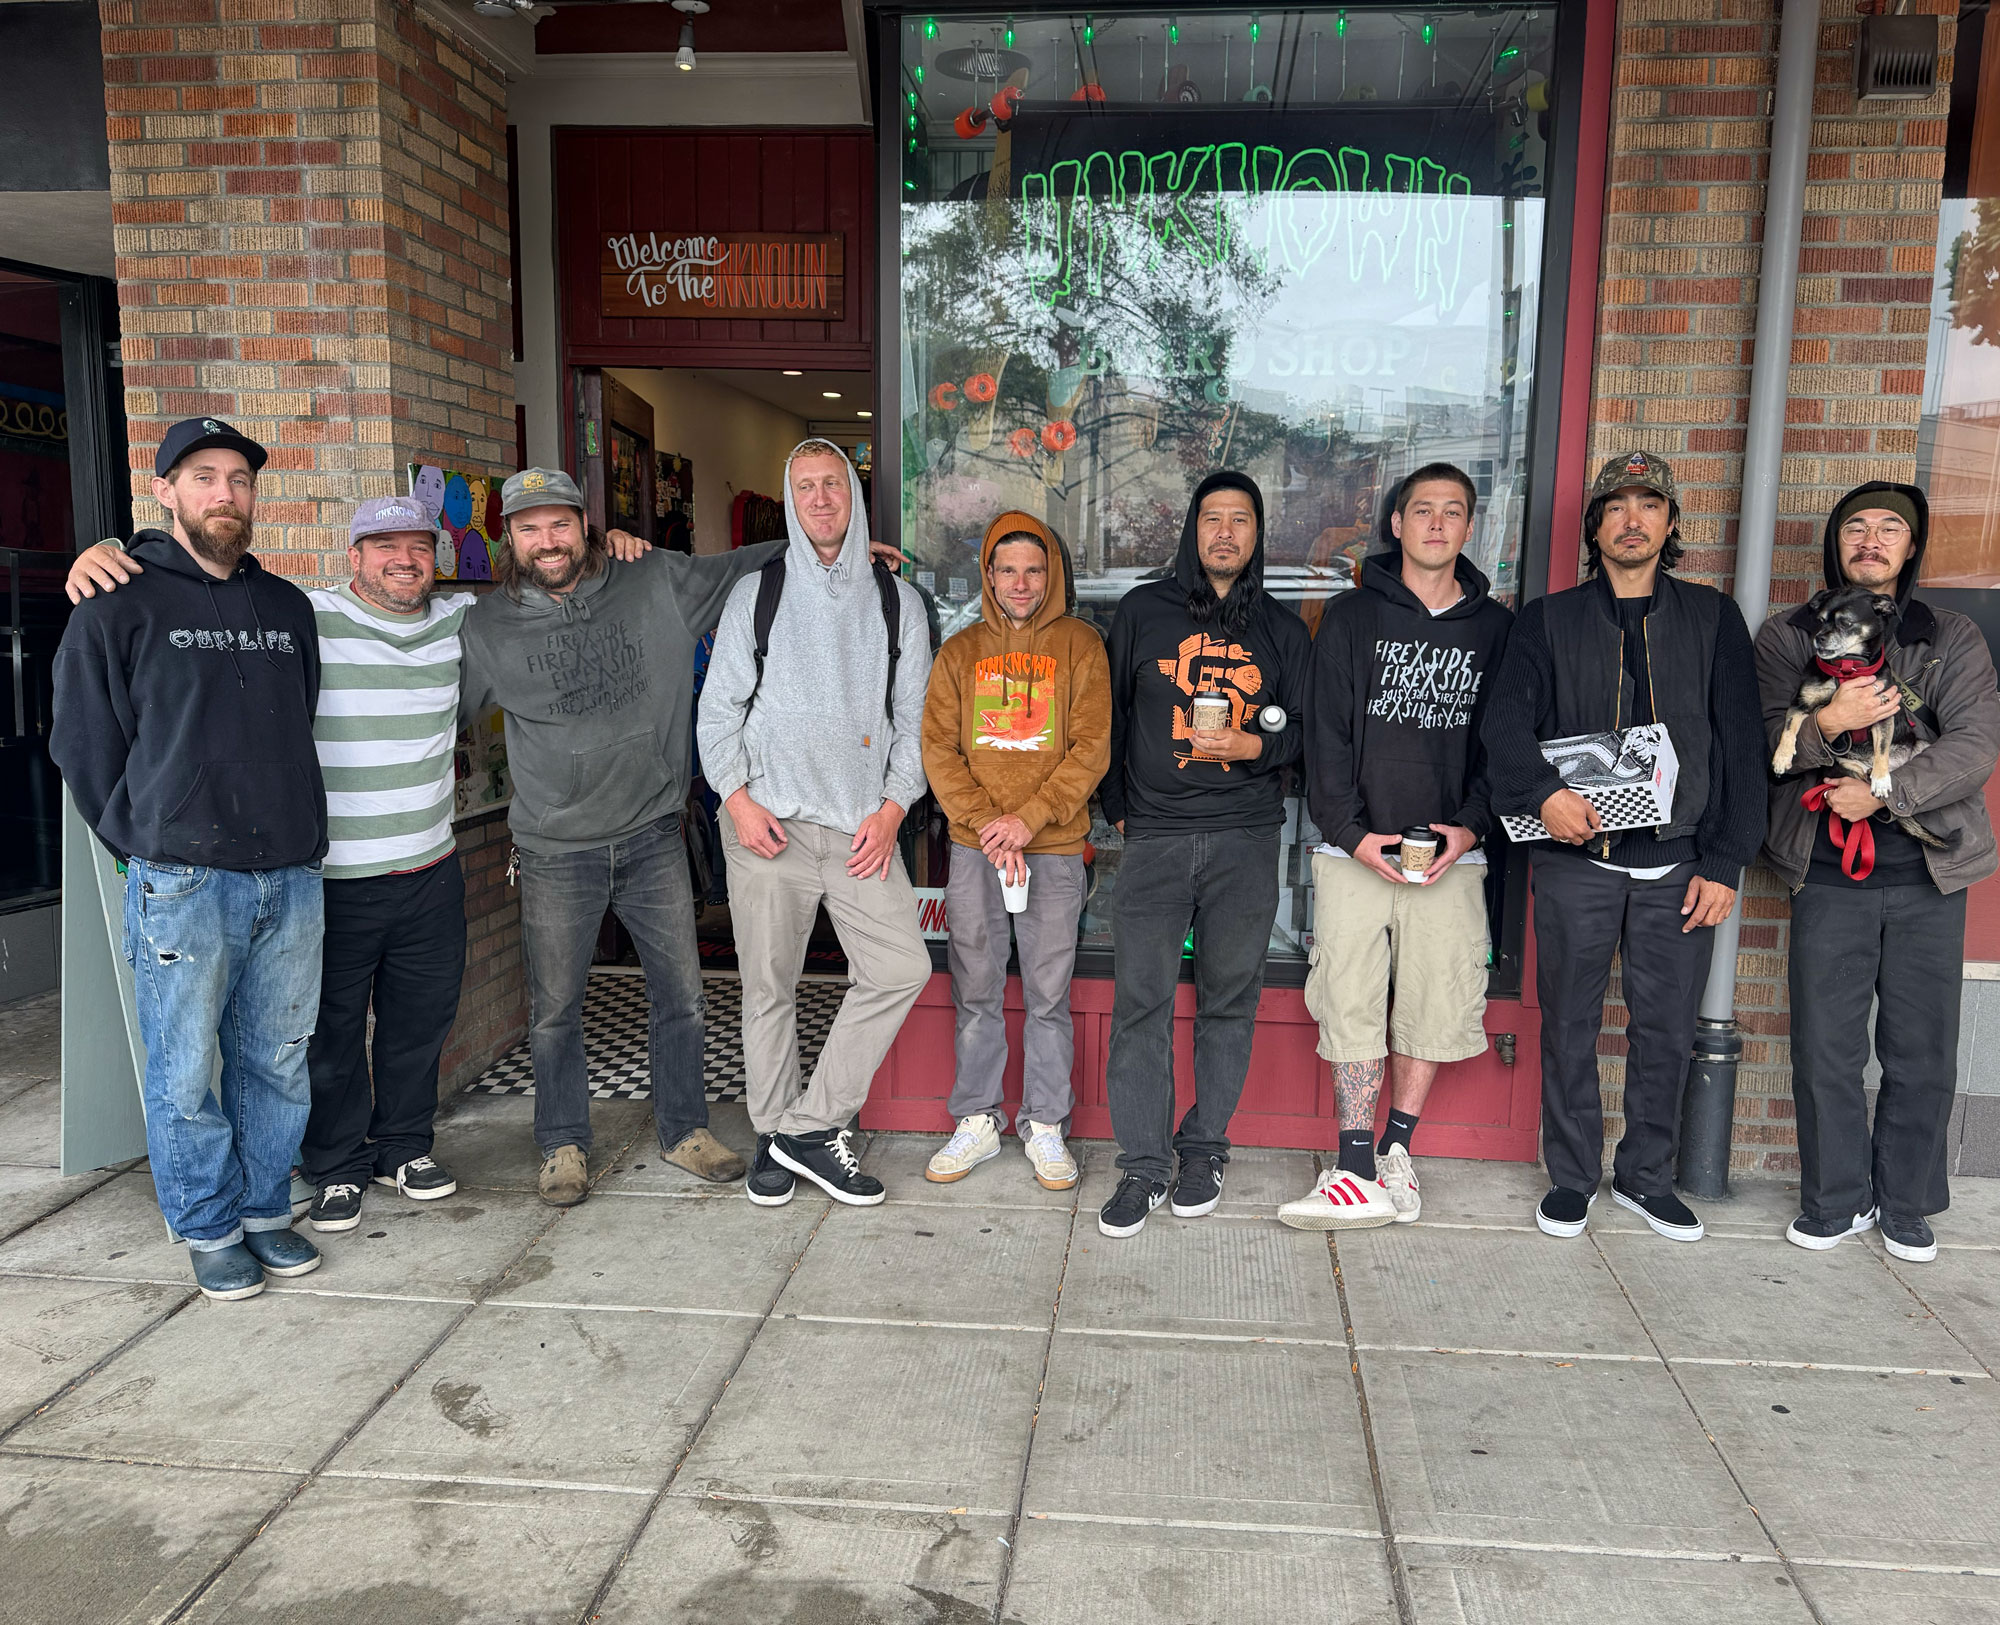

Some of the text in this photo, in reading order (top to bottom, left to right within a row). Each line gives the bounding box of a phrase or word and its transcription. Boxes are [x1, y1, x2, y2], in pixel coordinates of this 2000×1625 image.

[607, 231, 718, 271] Welcome
[1022, 142, 1472, 311] UNKNOWN
[626, 250, 730, 307] To The
[702, 242, 827, 309] UNKNOWN
[1076, 328, 1411, 377] BARD SHOP
[975, 651, 1057, 683] UNKNOWN
